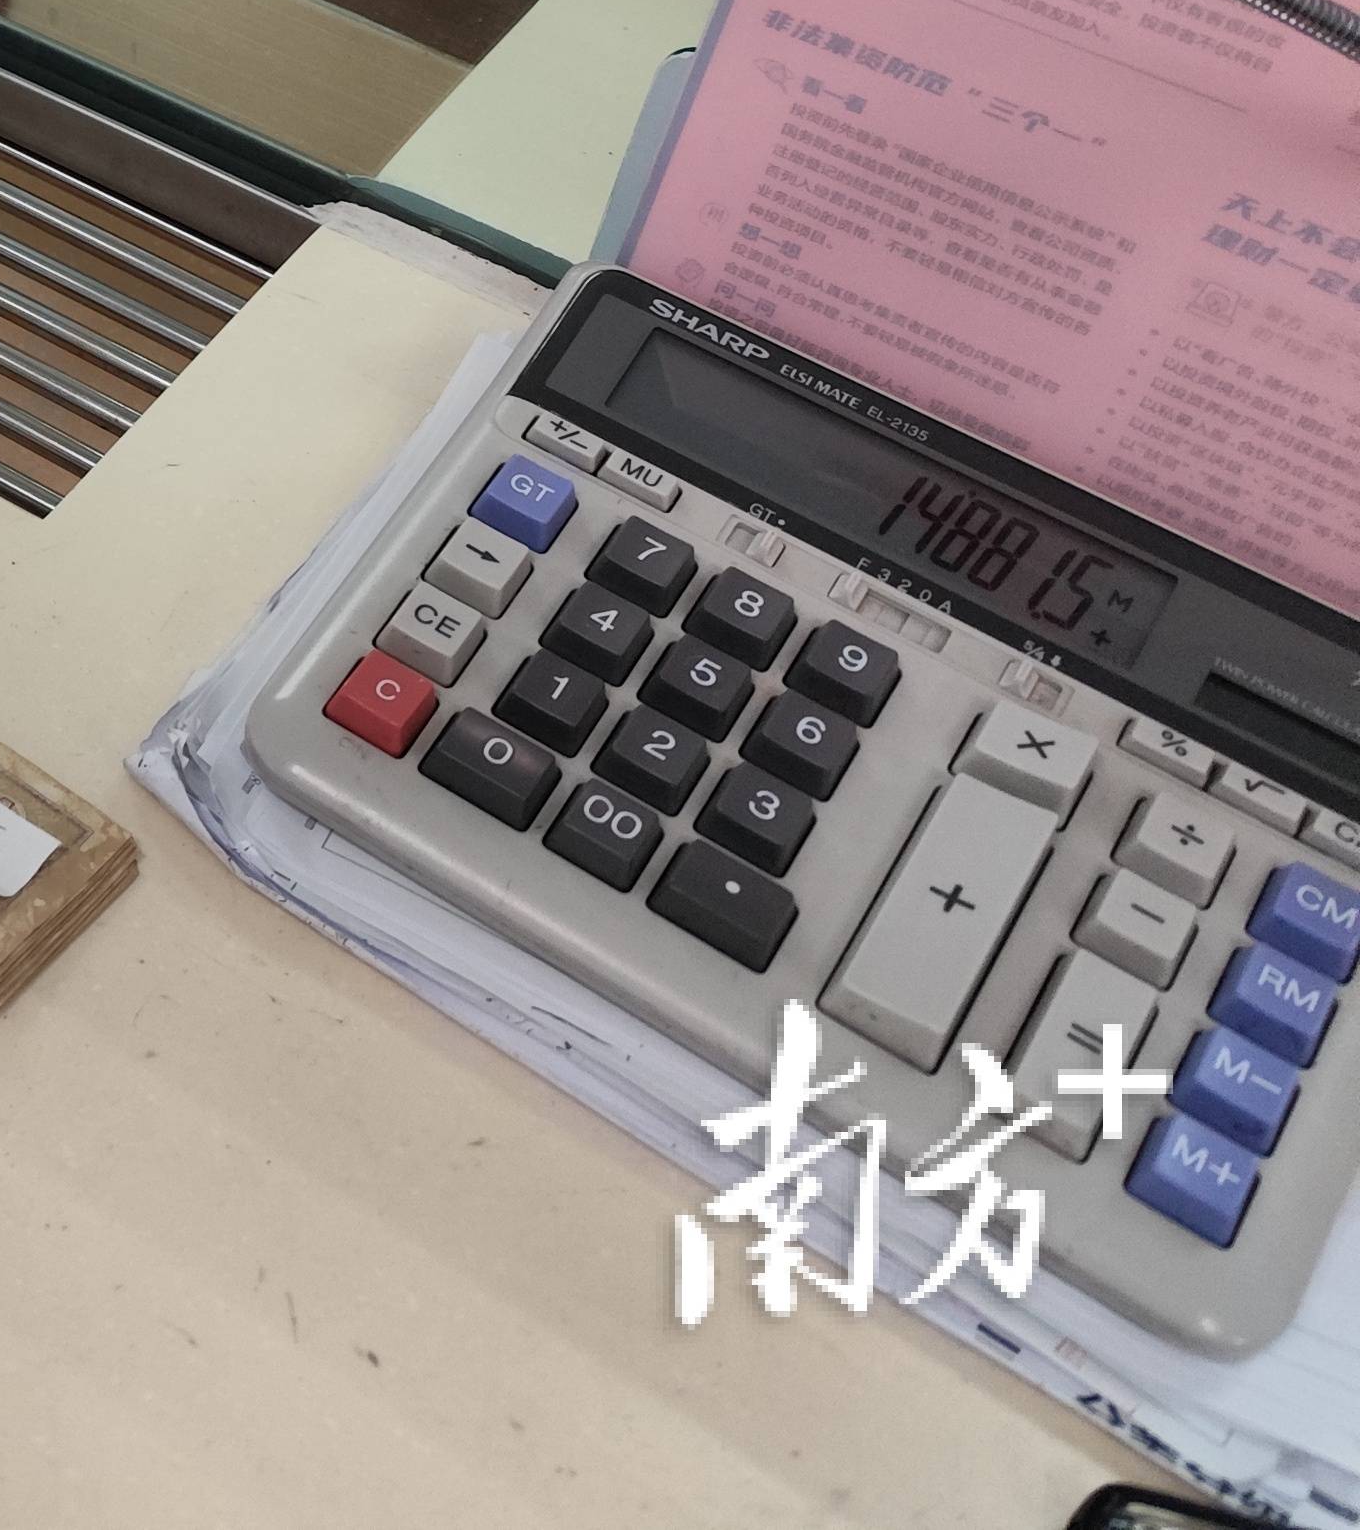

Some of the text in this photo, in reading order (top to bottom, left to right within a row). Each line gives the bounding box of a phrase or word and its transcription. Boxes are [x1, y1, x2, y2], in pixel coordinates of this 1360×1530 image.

[646, 297, 772, 362] SHARP
[866, 406, 930, 443] EL-2135
[510, 472, 556, 503] GT
[620, 457, 663, 488] MU
[749, 502, 776, 523] GT
[635, 536, 668, 562] 7
[732, 589, 766, 619] 8
[413, 603, 461, 639] CE
[589, 607, 621, 633] 4
[689, 657, 722, 687] 5
[836, 643, 869, 673] 9
[374, 678, 401, 702] C
[549, 675, 571, 701] 1
[643, 729, 677, 761] 2
[795, 715, 827, 745] 6
[482, 737, 515, 765] 0
[582, 793, 643, 839] 00
[748, 788, 782, 821] 3
[1294, 882, 1358, 931] CM
[1257, 964, 1320, 1015] RM
[1172, 1135, 1241, 1188] M+
